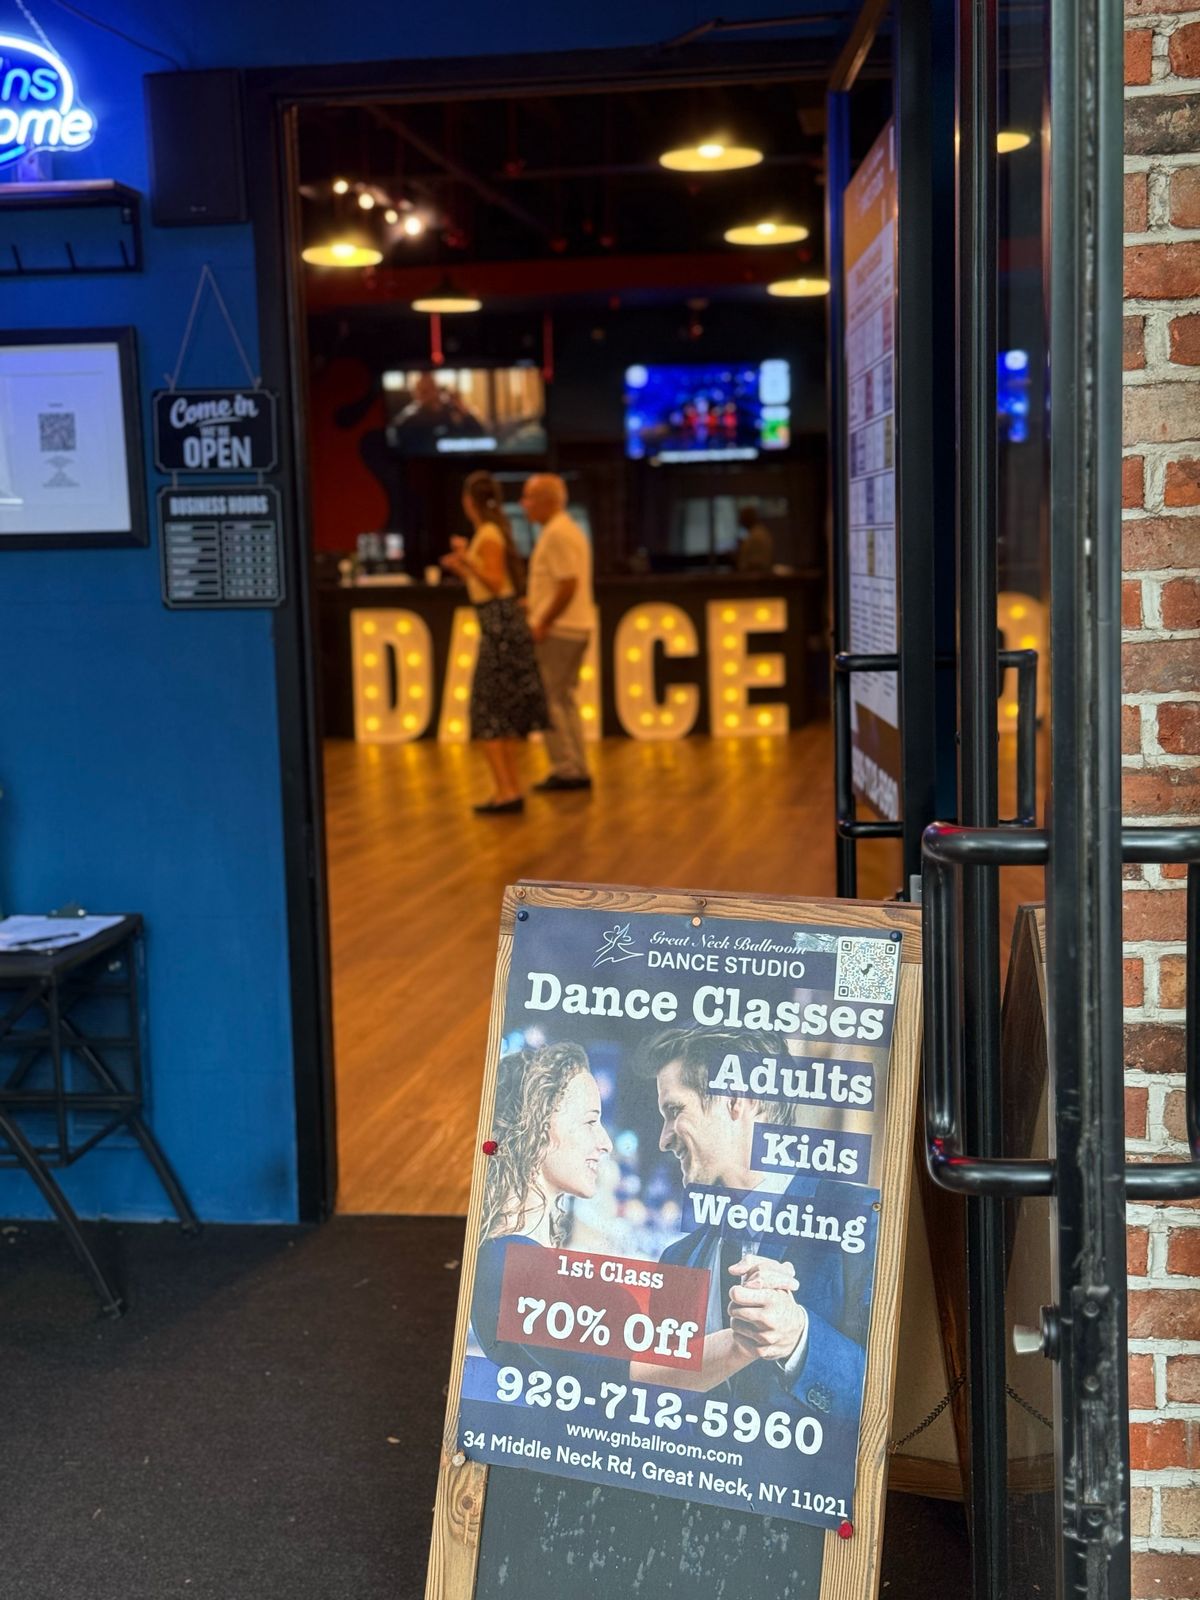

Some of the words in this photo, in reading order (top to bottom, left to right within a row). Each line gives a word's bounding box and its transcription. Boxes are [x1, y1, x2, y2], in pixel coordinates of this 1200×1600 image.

[170, 397, 232, 429] Come
[233, 394, 259, 418] in
[183, 436, 252, 468] OPEN
[647, 950, 719, 974] DANCE
[724, 958, 806, 980] STUDIO
[649, 931, 691, 947] Great
[691, 934, 731, 951] Neck
[734, 936, 808, 955] Ballroom
[524, 971, 679, 1023] Dance
[691, 985, 885, 1041] Classes
[708, 1054, 874, 1106] Adults
[760, 1132, 859, 1176] Kids
[688, 1191, 867, 1255] Wedding
[556, 1255, 595, 1280] 1st
[599, 1264, 665, 1290] Class
[517, 1296, 611, 1347] 70%
[622, 1312, 699, 1360] Off
[496, 1366, 824, 1456] 929-712-5960
[566, 1423, 744, 1467] www.gnballroom.com
[463, 1430, 486, 1450] 34
[490, 1435, 552, 1461] Middle
[556, 1447, 603, 1471] Neck
[606, 1455, 638, 1480] Rd,
[641, 1460, 695, 1488] Great
[698, 1473, 754, 1502] Neck,
[758, 1482, 788, 1502] NY
[790, 1489, 849, 1519] 11021
